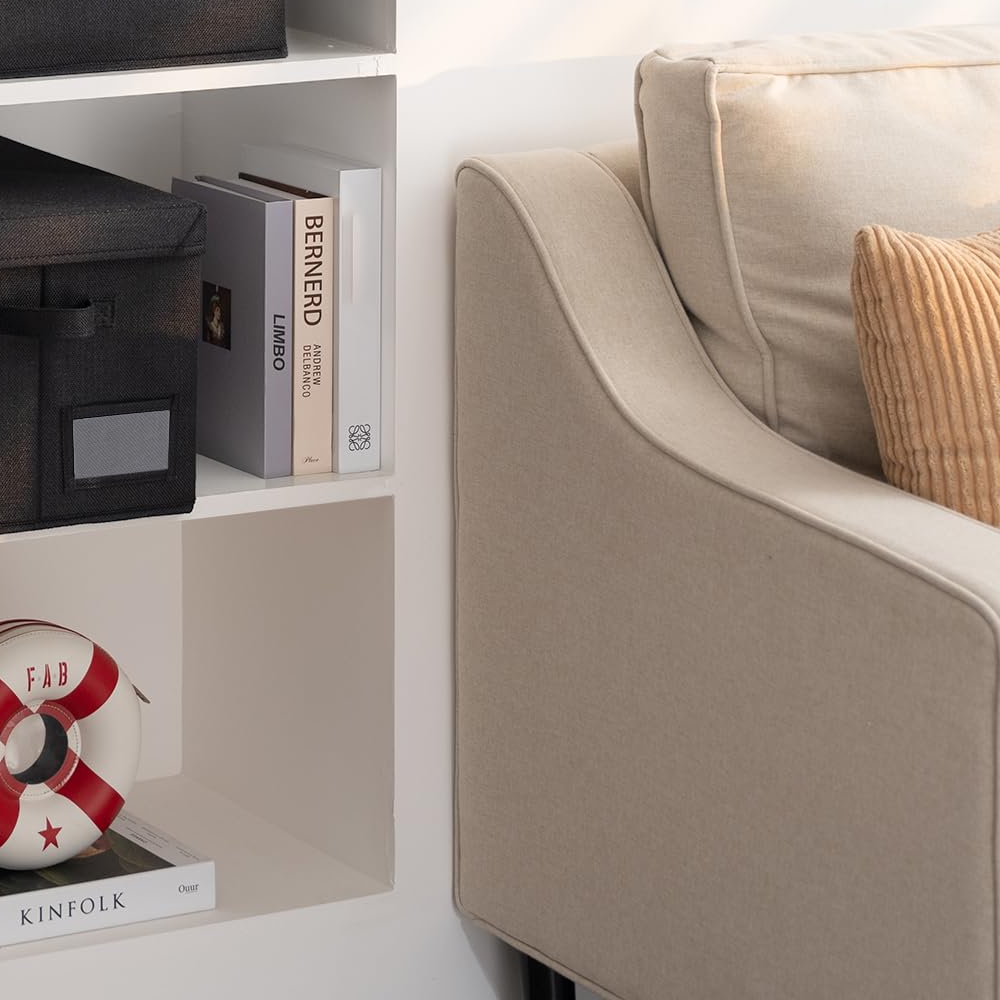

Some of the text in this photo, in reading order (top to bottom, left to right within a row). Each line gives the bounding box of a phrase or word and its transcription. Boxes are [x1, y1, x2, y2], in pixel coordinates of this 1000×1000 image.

[303, 215, 324, 327] BERNERD
[273, 314, 286, 371] LIMBO
[312, 344, 321, 386] ANDREW
[302, 344, 311, 398] DELBANCO
[20, 892, 126, 926] KINFOLK
